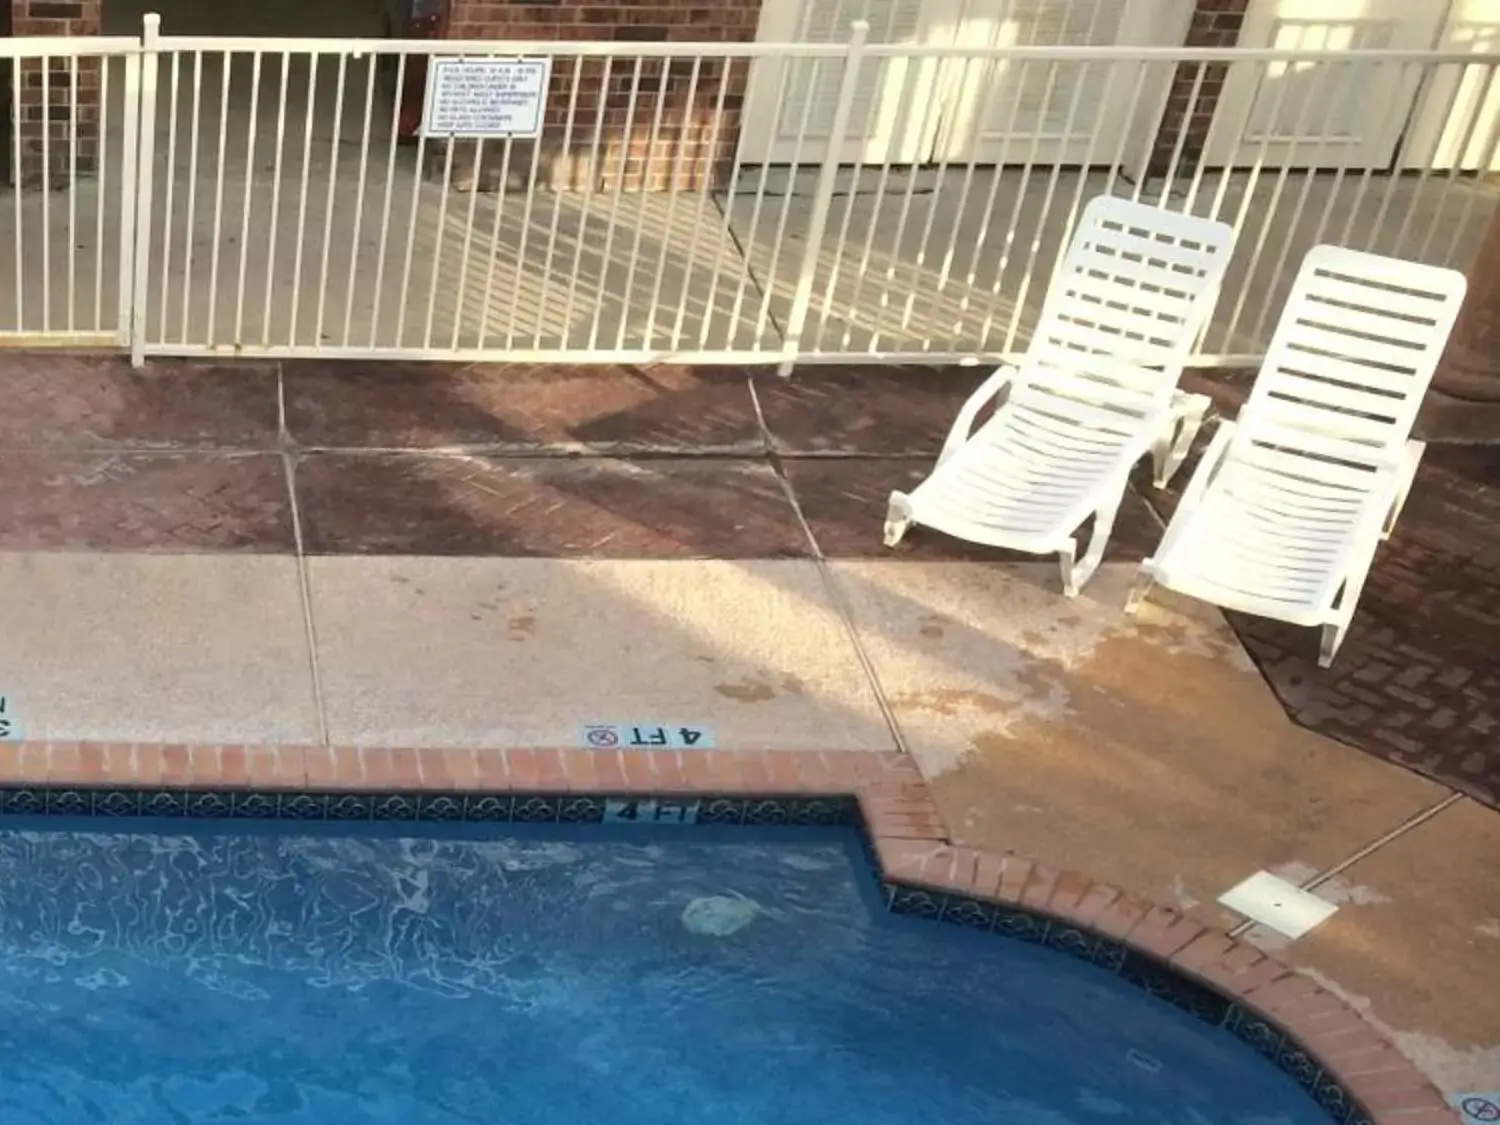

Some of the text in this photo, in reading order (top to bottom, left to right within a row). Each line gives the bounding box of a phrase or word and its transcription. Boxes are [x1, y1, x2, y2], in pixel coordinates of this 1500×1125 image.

[630, 727, 702, 745] 4 FT
[616, 801, 638, 821] 4
